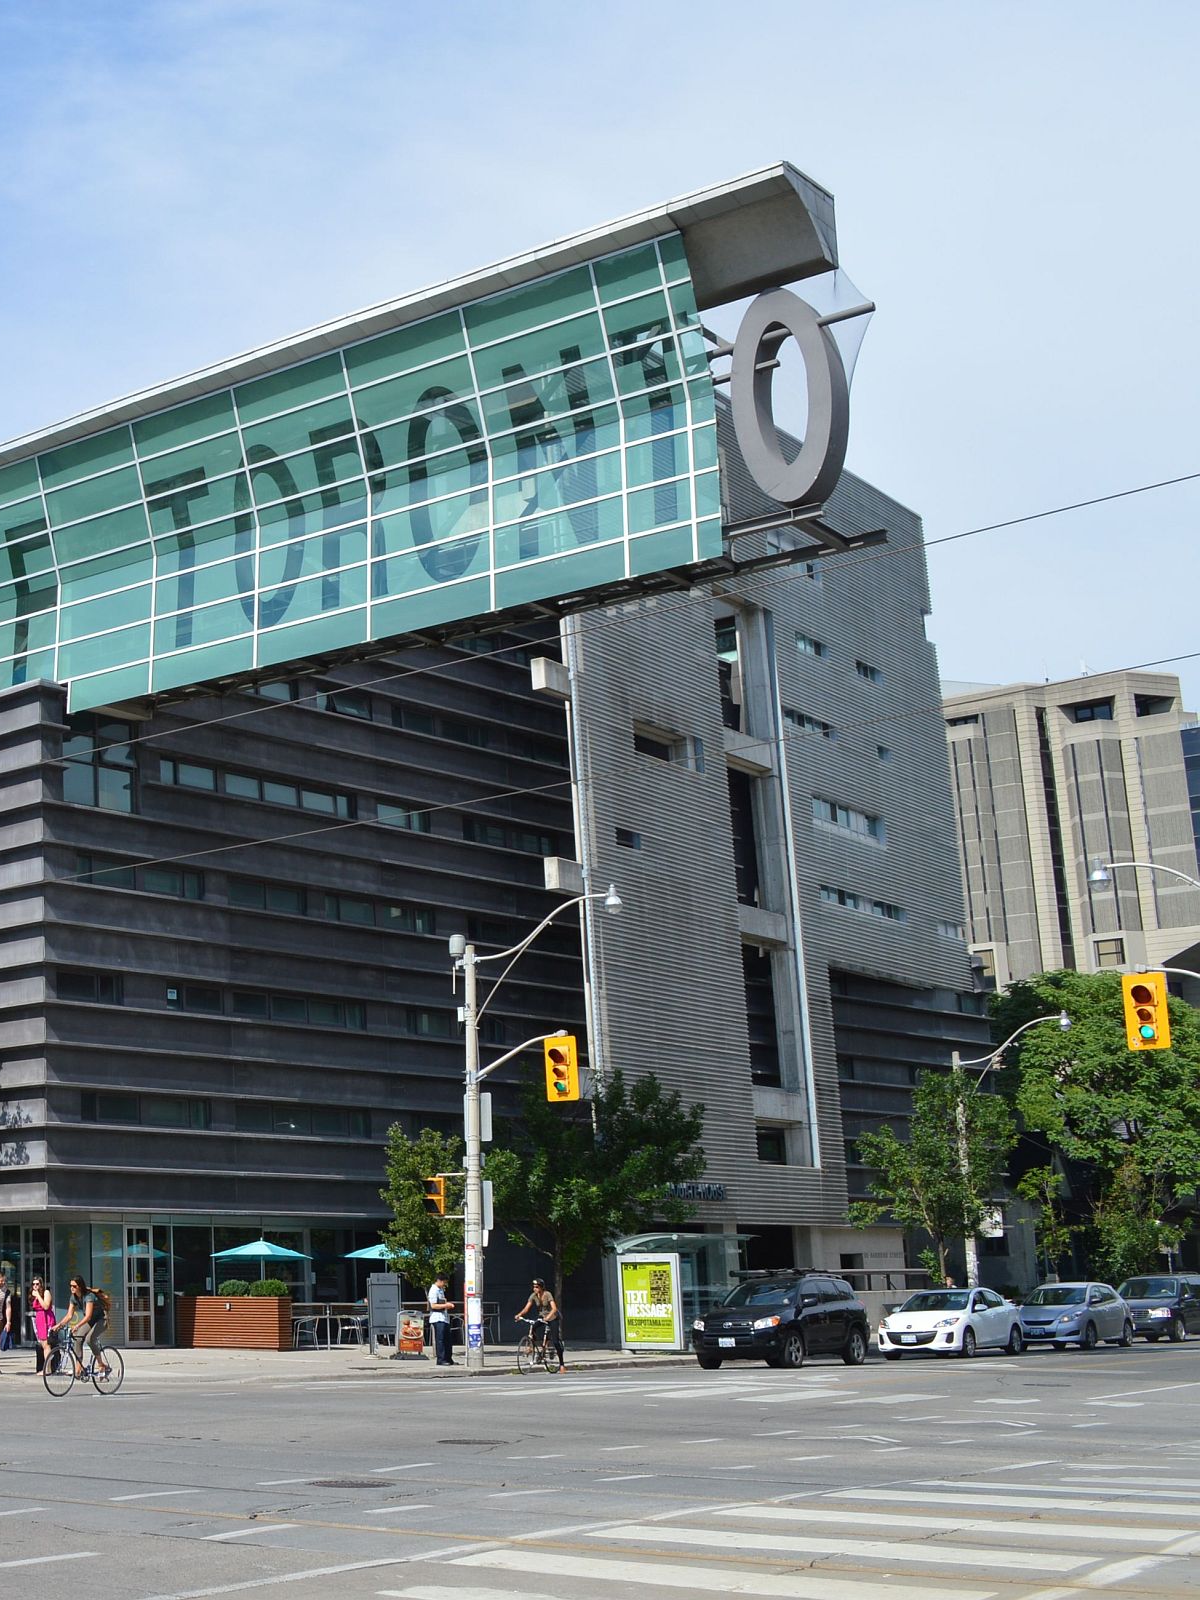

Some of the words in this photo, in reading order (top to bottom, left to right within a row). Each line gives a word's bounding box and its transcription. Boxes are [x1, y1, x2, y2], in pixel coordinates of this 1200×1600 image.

[144, 287, 850, 649] TORONTO
[625, 1290, 648, 1304] TEXT
[626, 1303, 673, 1318] MESSAGE?
